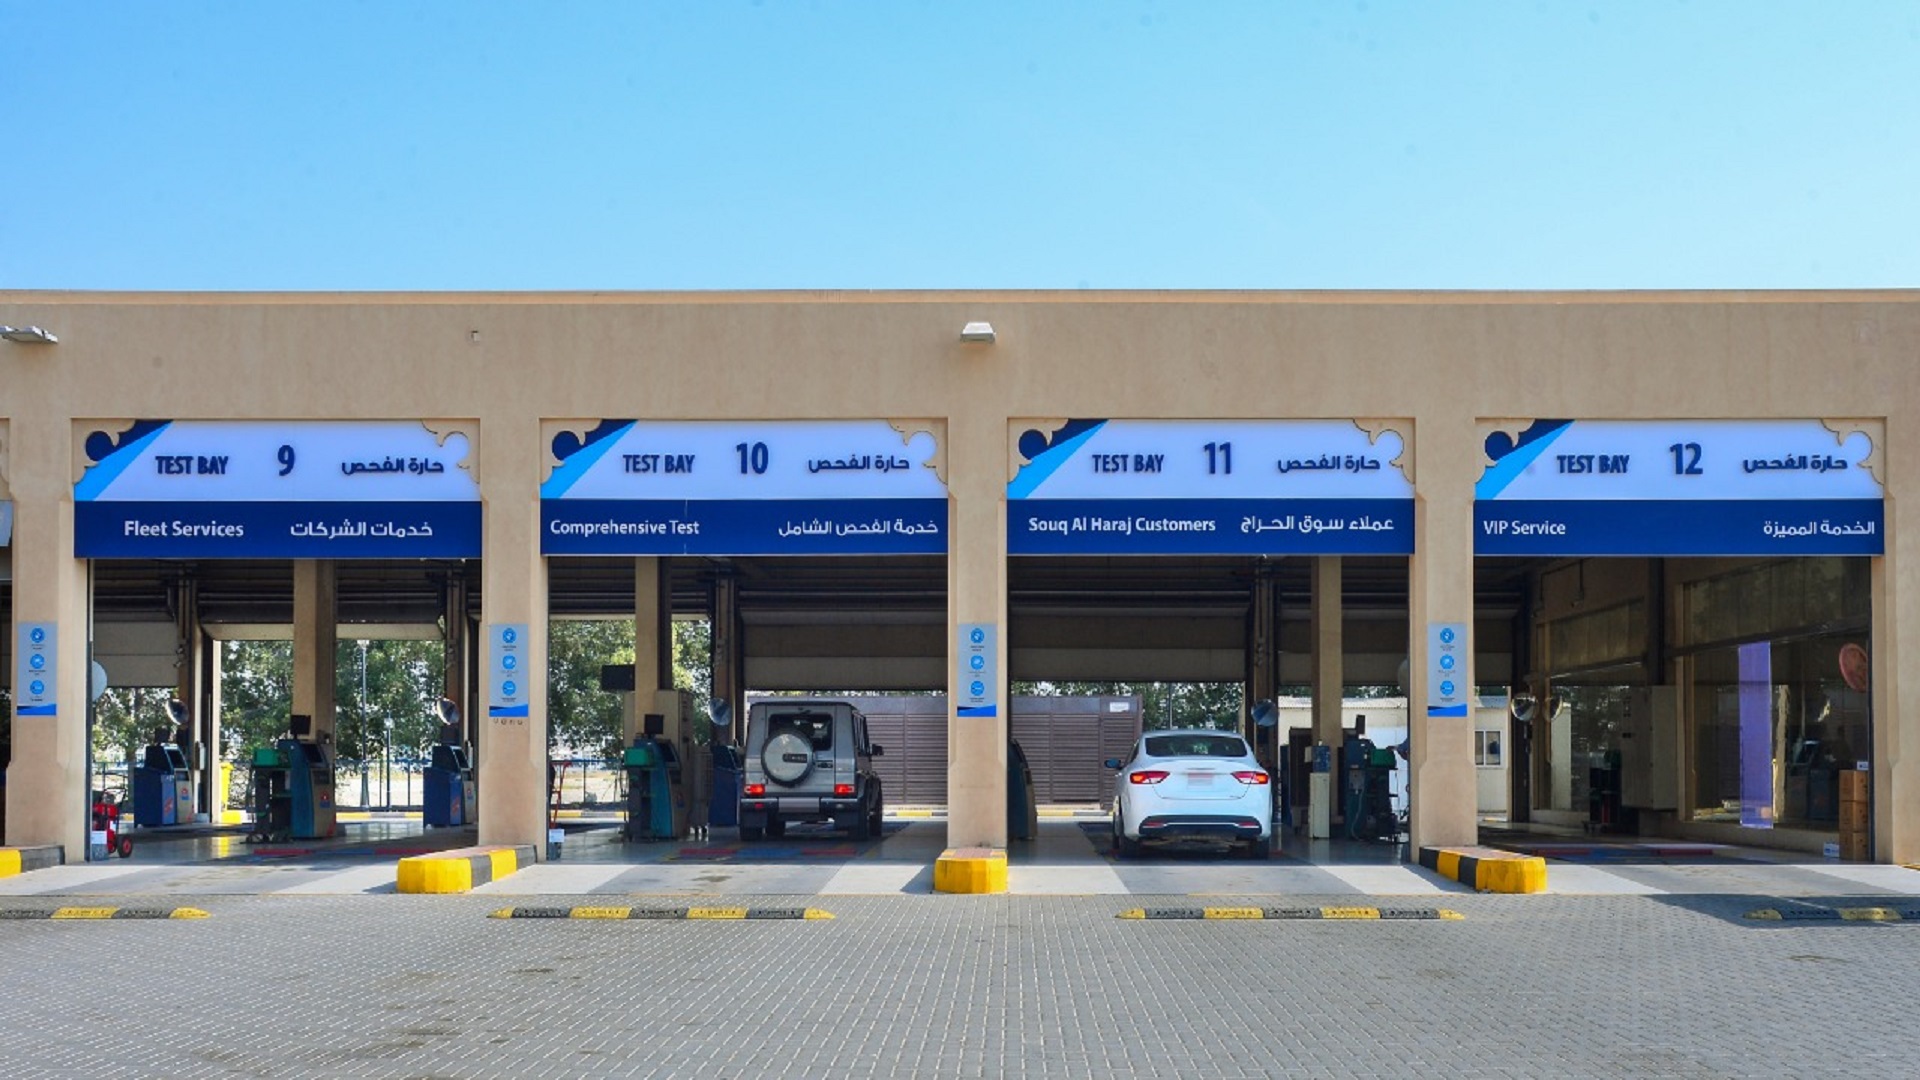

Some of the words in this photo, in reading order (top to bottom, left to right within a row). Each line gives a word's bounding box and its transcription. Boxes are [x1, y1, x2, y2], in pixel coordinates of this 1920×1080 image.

[155, 455, 194, 475] TEST
[198, 455, 228, 475] BAY
[277, 444, 295, 476] 9
[341, 456, 404, 475] الفحص
[408, 457, 444, 475] حارة
[623, 454, 660, 474] TEST
[664, 454, 695, 474] BAY
[735, 442, 769, 475] 10
[808, 454, 870, 473] الفحص
[875, 454, 910, 474] حارة
[1092, 454, 1129, 473] TEST
[1134, 454, 1164, 473] BAY
[1203, 441, 1232, 475] 11
[1277, 454, 1340, 474] الفحص
[1344, 454, 1381, 474] حارة
[1556, 454, 1595, 474] TEST
[1599, 454, 1629, 474] BAY
[1669, 443, 1703, 475] 12
[1743, 454, 1808, 474] الفحص
[1811, 454, 1848, 474] حارة
[124, 520, 168, 537] Fleet
[172, 520, 244, 537] Services
[290, 518, 366, 540] الشركات
[371, 521, 433, 538] خدمات
[550, 518, 667, 538] Comprehensive
[668, 519, 700, 535] Test
[778, 517, 832, 538] الشامل
[835, 518, 891, 537] الفحص
[894, 518, 938, 536] خدمة
[1028, 517, 1068, 536] Souq
[1072, 516, 1087, 532] Al
[1090, 516, 1132, 536] Haraj
[1135, 517, 1216, 532] Customers
[1298, 515, 1344, 534] سوق
[1348, 515, 1395, 532] عملاء
[1483, 520, 1509, 535] VIP
[1511, 520, 1566, 535] Service
[1763, 520, 1818, 539] المميزة
[1819, 519, 1875, 536] الخدمة
